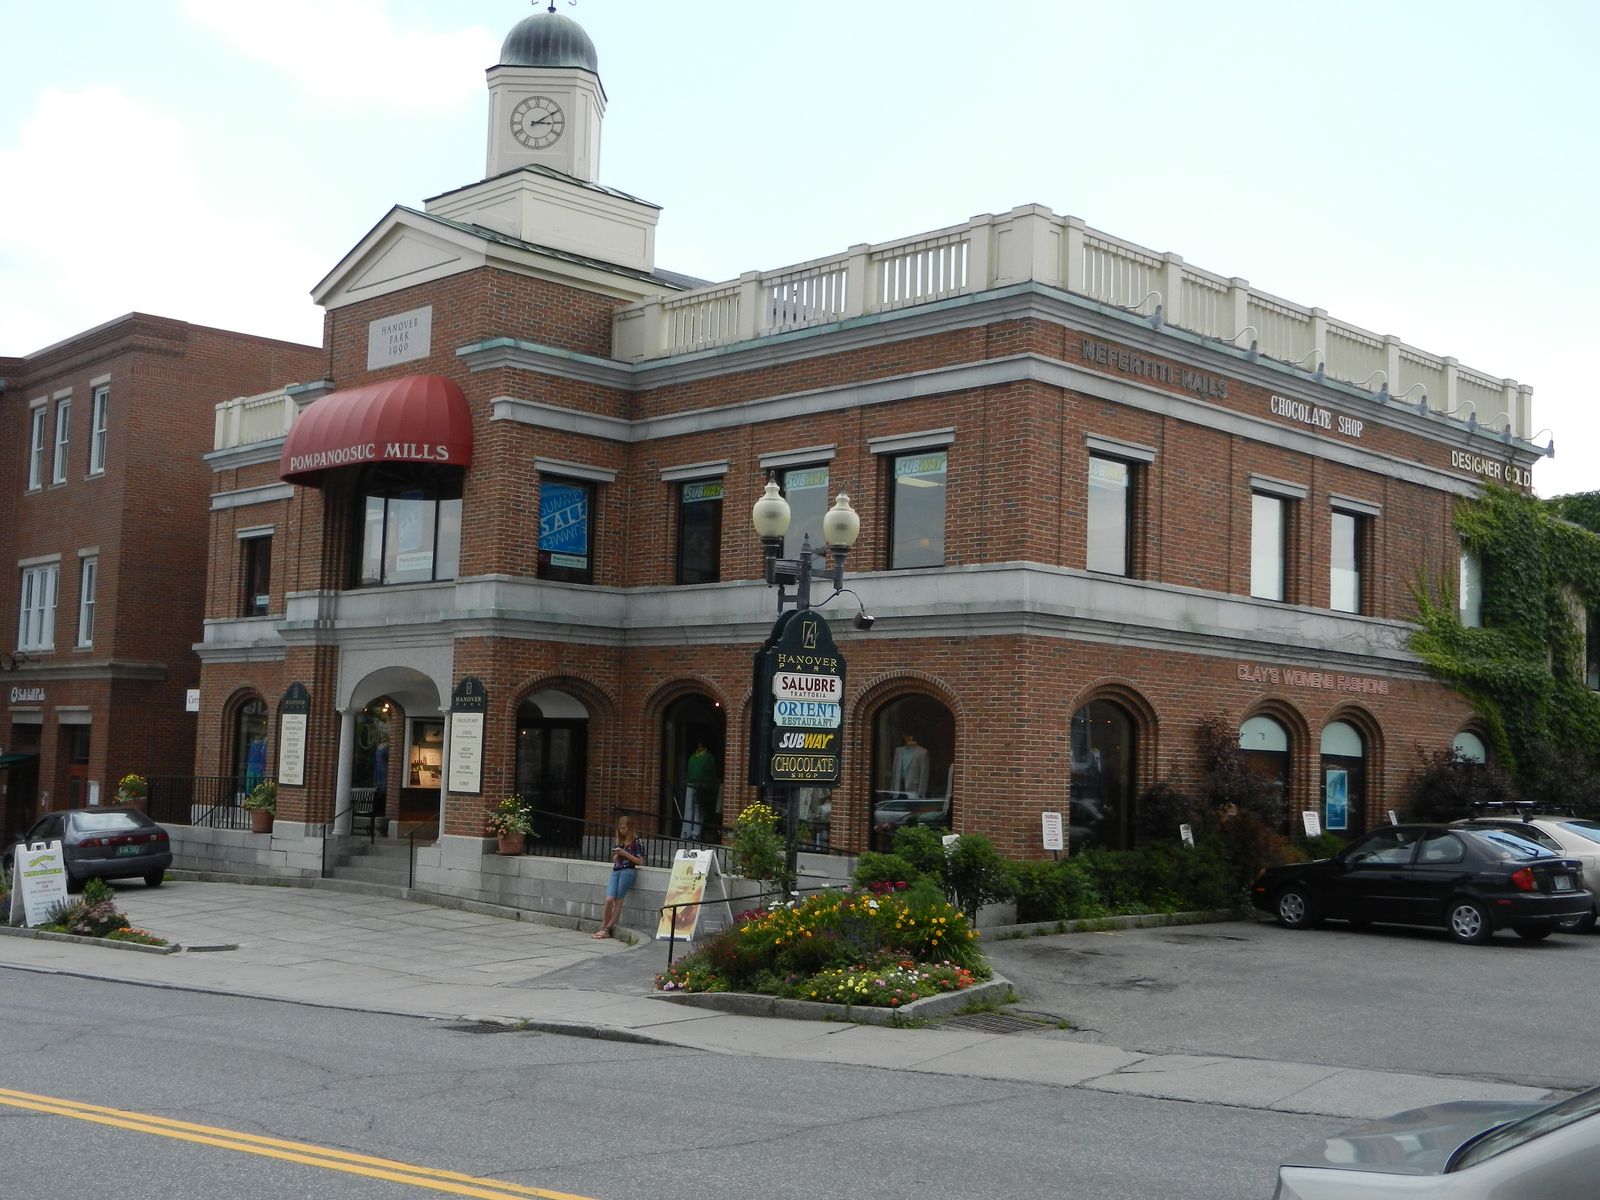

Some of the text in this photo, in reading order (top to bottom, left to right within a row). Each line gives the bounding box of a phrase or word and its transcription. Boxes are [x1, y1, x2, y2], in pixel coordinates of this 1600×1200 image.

[381, 317, 419, 336] HANOVER
[389, 331, 409, 345] PARK
[1082, 339, 1230, 399] NEFERTITI NAILS
[1270, 395, 1363, 438] CHOCOLATE SHOP
[290, 442, 449, 472] POMPANOOSUC MILLS
[898, 457, 943, 474] SUBWAY
[1451, 449, 1531, 487] DESIGNER GOLD
[786, 471, 827, 488] SUBWAY
[685, 483, 723, 499] SUBWAY
[540, 500, 586, 536] SALE
[778, 653, 837, 668] HANOVER
[778, 663, 836, 674] PARK
[782, 676, 836, 693] SALUBRE
[1237, 664, 1389, 696] CLAY'S WOMENS FASHIONS
[790, 690, 827, 698] TRATTORIA
[777, 701, 838, 718] ORIENT
[782, 717, 834, 727] RESTAURANT
[779, 732, 834, 749] SUBWAY
[774, 756, 835, 773] CHOCOLATE
